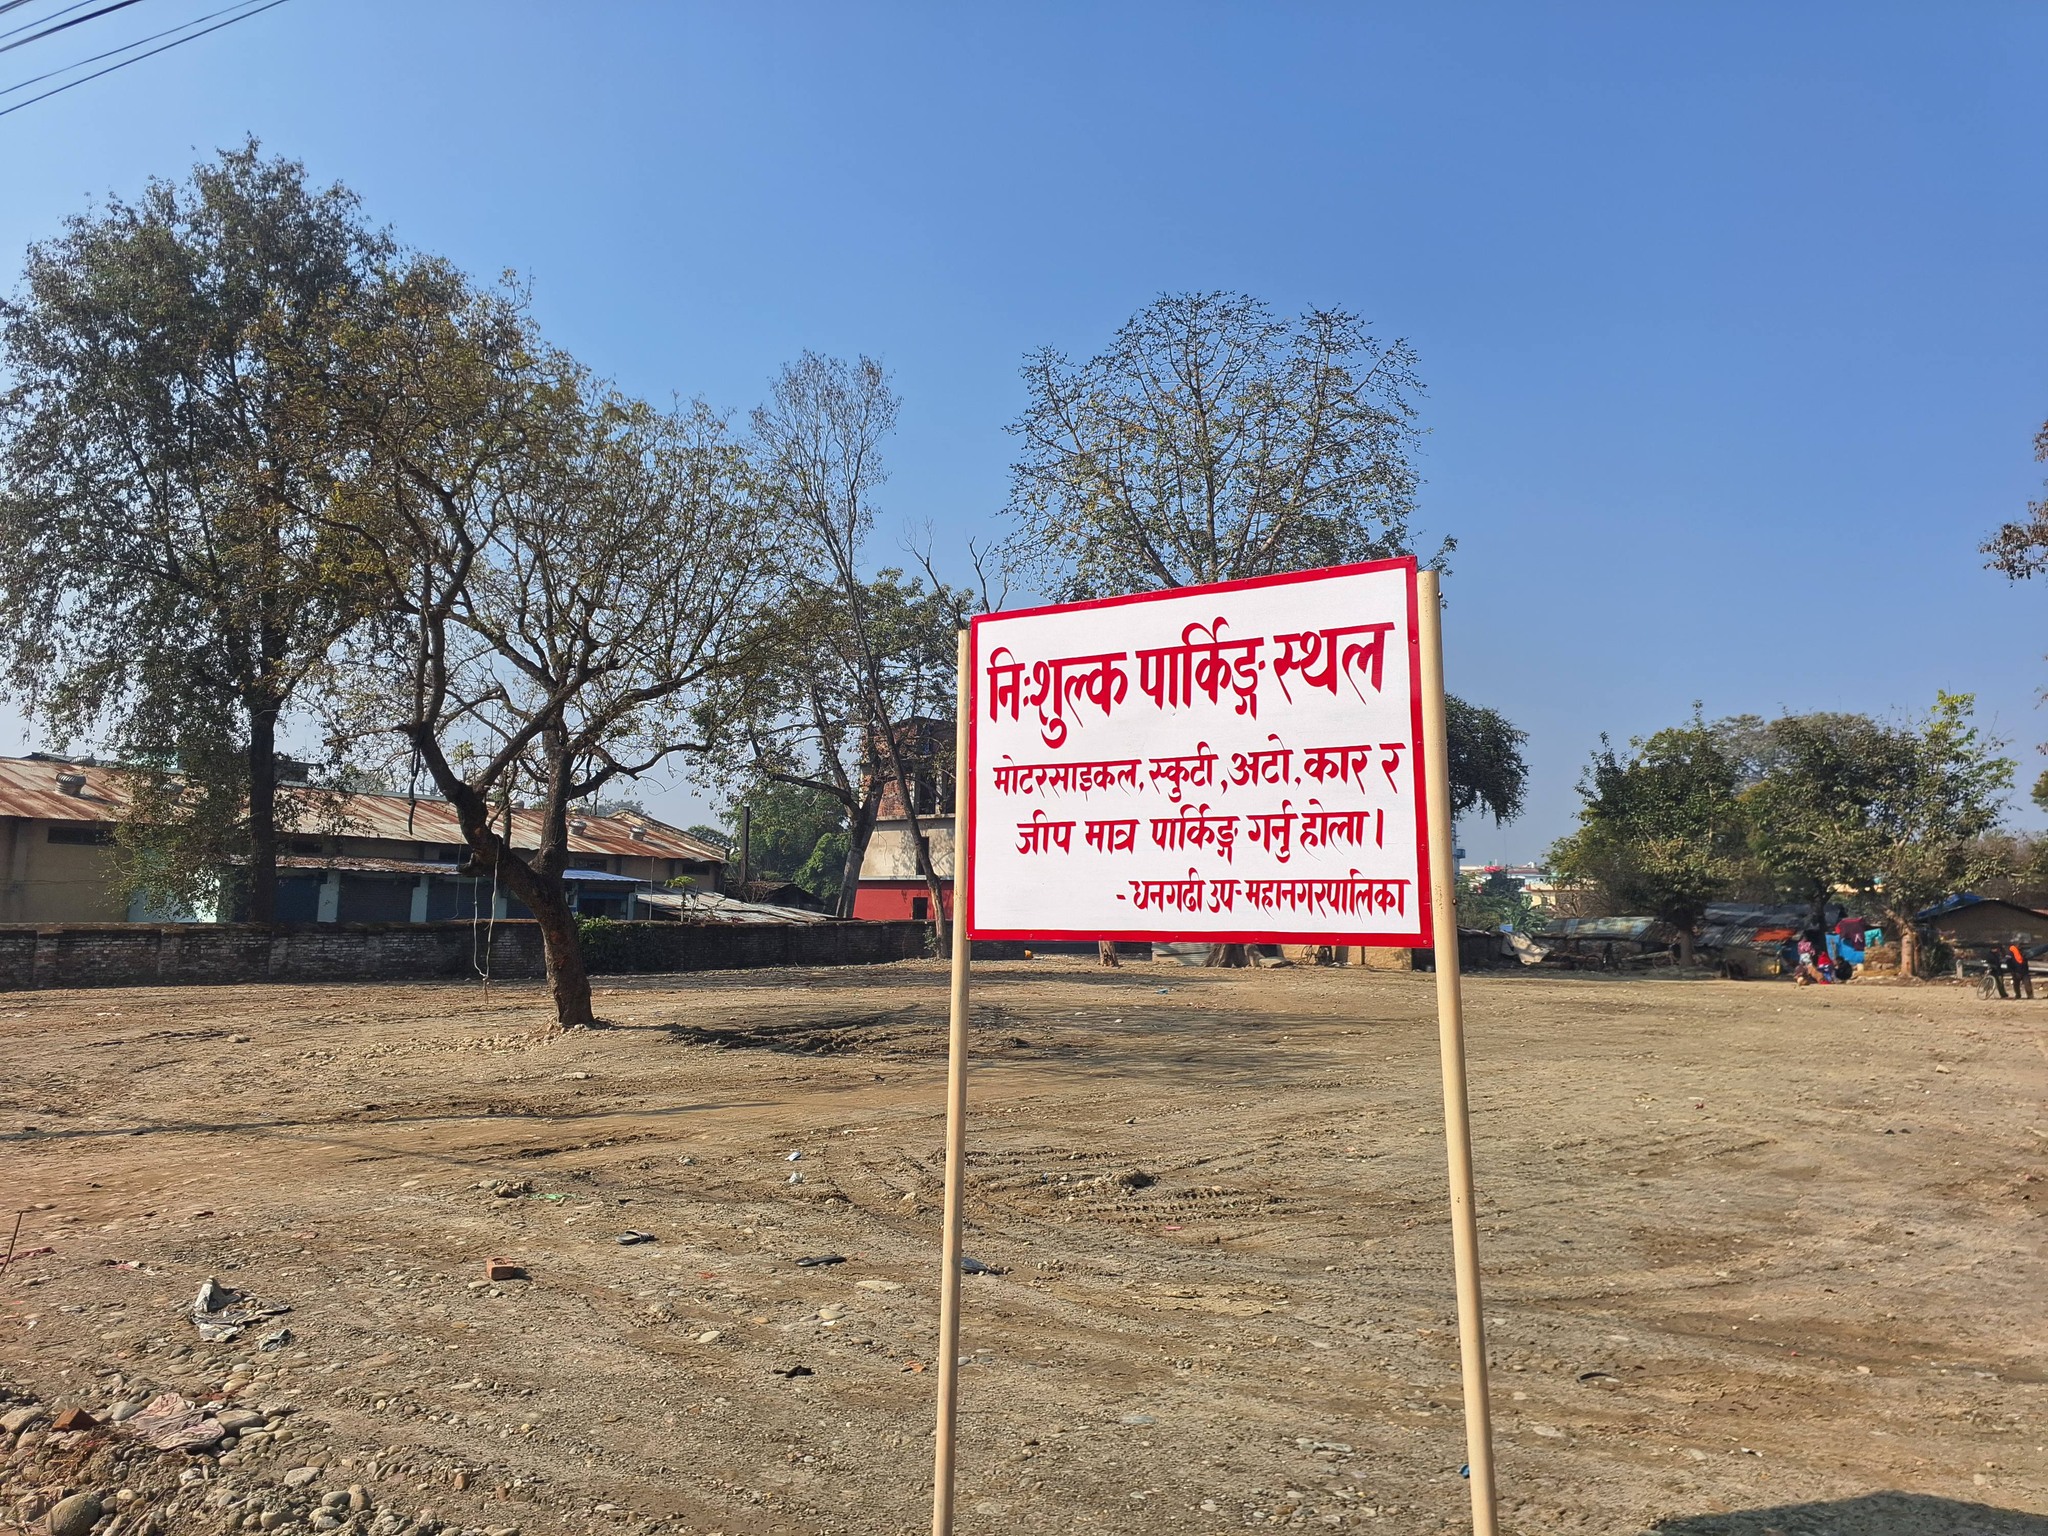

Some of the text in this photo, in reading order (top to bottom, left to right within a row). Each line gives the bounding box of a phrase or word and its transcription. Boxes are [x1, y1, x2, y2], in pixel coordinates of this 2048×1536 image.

[987, 647, 1128, 749] निःशुल्क
[1273, 622, 1395, 703] स्थल
[1304, 745, 1372, 794] कार
[1380, 743, 1406, 793] र
[1015, 809, 1076, 855] जीप
[1085, 819, 1140, 854] मात्र
[1247, 800, 1298, 864] गर्नु
